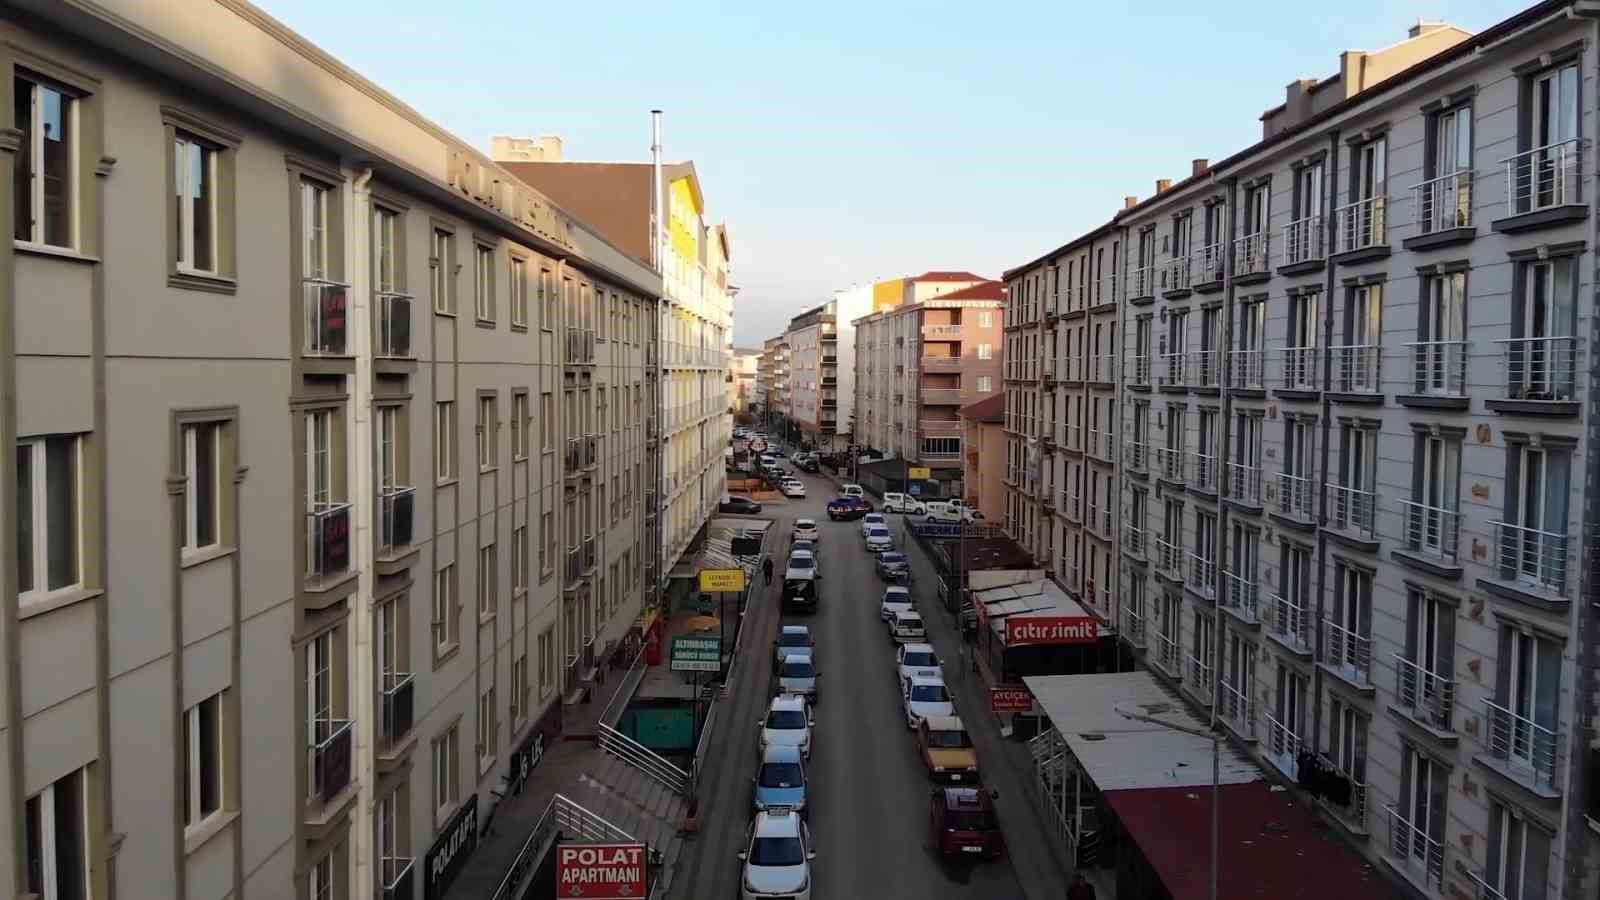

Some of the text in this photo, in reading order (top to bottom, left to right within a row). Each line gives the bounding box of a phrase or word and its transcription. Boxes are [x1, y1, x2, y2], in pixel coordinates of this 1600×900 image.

[1050, 621, 1094, 638] simit
[562, 848, 643, 866] POLAT
[561, 867, 640, 883] APARTMANI
